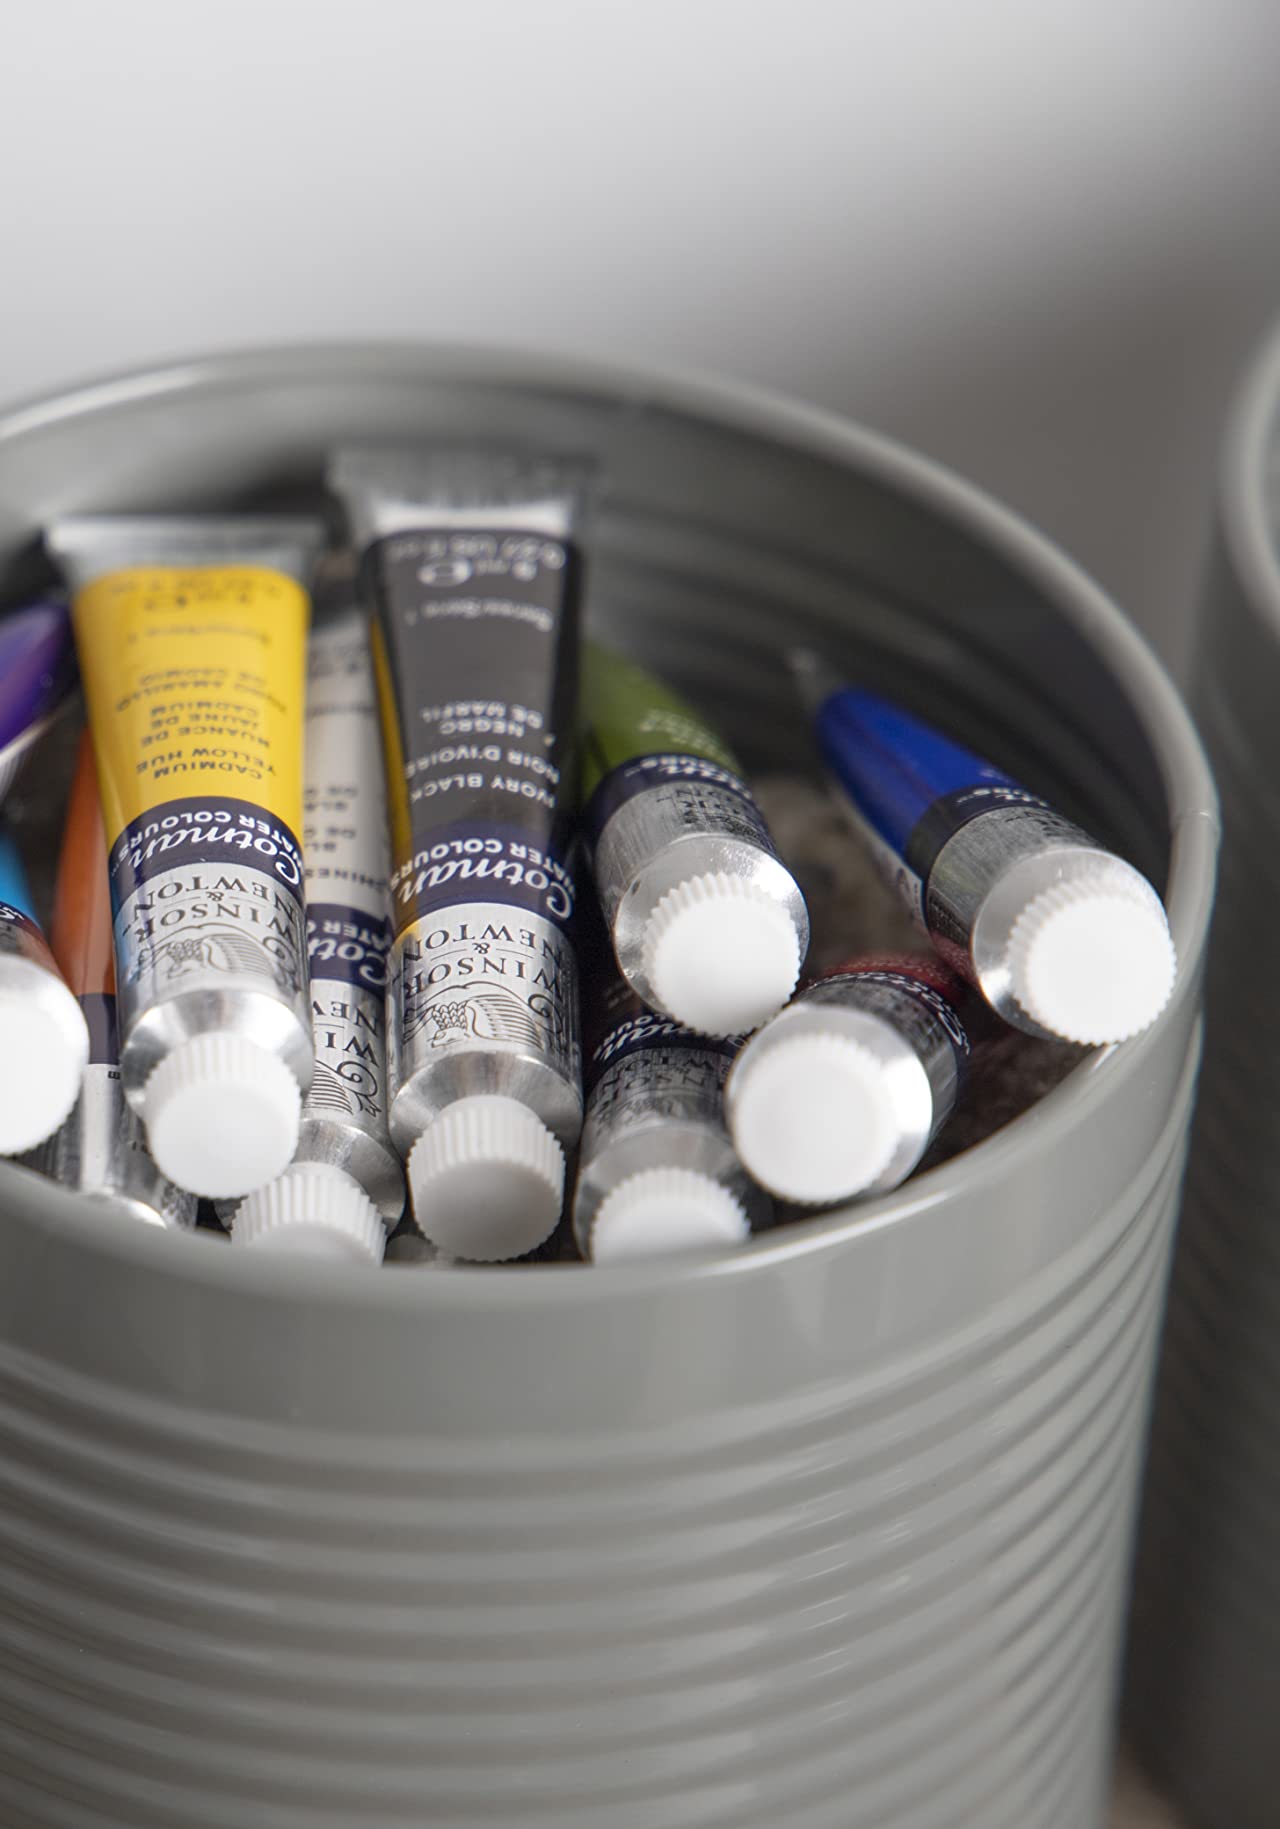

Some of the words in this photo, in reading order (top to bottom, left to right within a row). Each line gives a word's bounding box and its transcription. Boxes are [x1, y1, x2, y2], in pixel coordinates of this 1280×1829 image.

[139, 730, 169, 748] DE
[135, 750, 183, 775] HUE
[152, 762, 263, 780] CADMIUM
[191, 748, 276, 776] YELLOW
[409, 773, 483, 803] BLACK
[120, 810, 231, 860] COLOURS
[129, 826, 301, 885] Cotman
[131, 875, 298, 924] NEWTON
[205, 891, 224, 902] &
[396, 857, 573, 919] Cotman
[133, 903, 297, 952] WINSOR
[401, 923, 563, 968] NEWTON
[472, 942, 490, 954] &
[308, 937, 386, 985] Cot
[401, 957, 563, 1001] WINSOR
